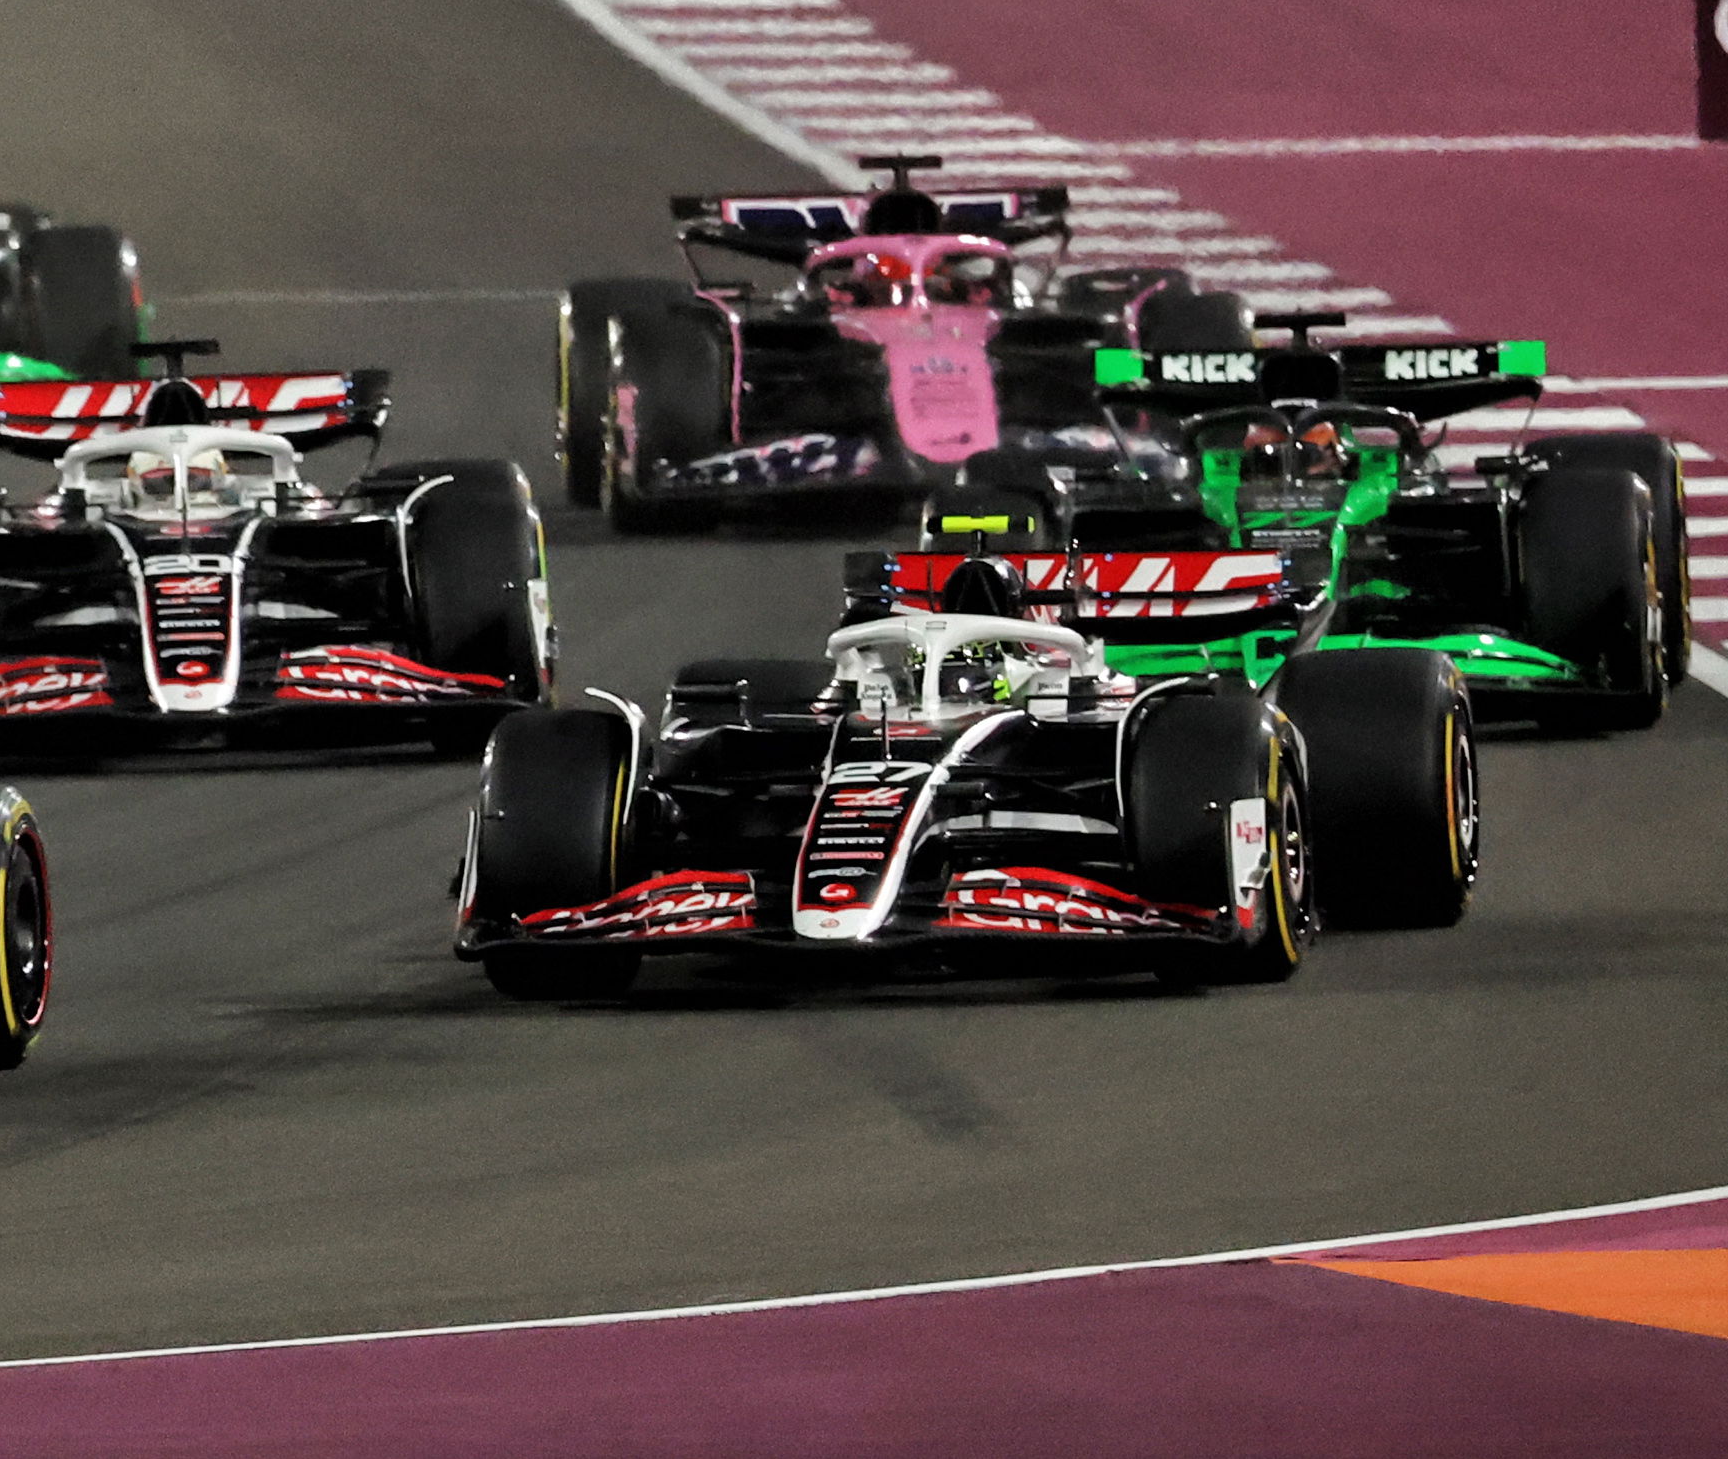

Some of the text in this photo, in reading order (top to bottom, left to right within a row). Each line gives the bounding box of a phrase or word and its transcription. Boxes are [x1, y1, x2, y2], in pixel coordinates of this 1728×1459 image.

[1161, 353, 1256, 383] KICK
[1384, 349, 1479, 380] KICK
[143, 553, 233, 576] 20
[826, 761, 934, 785] 27
